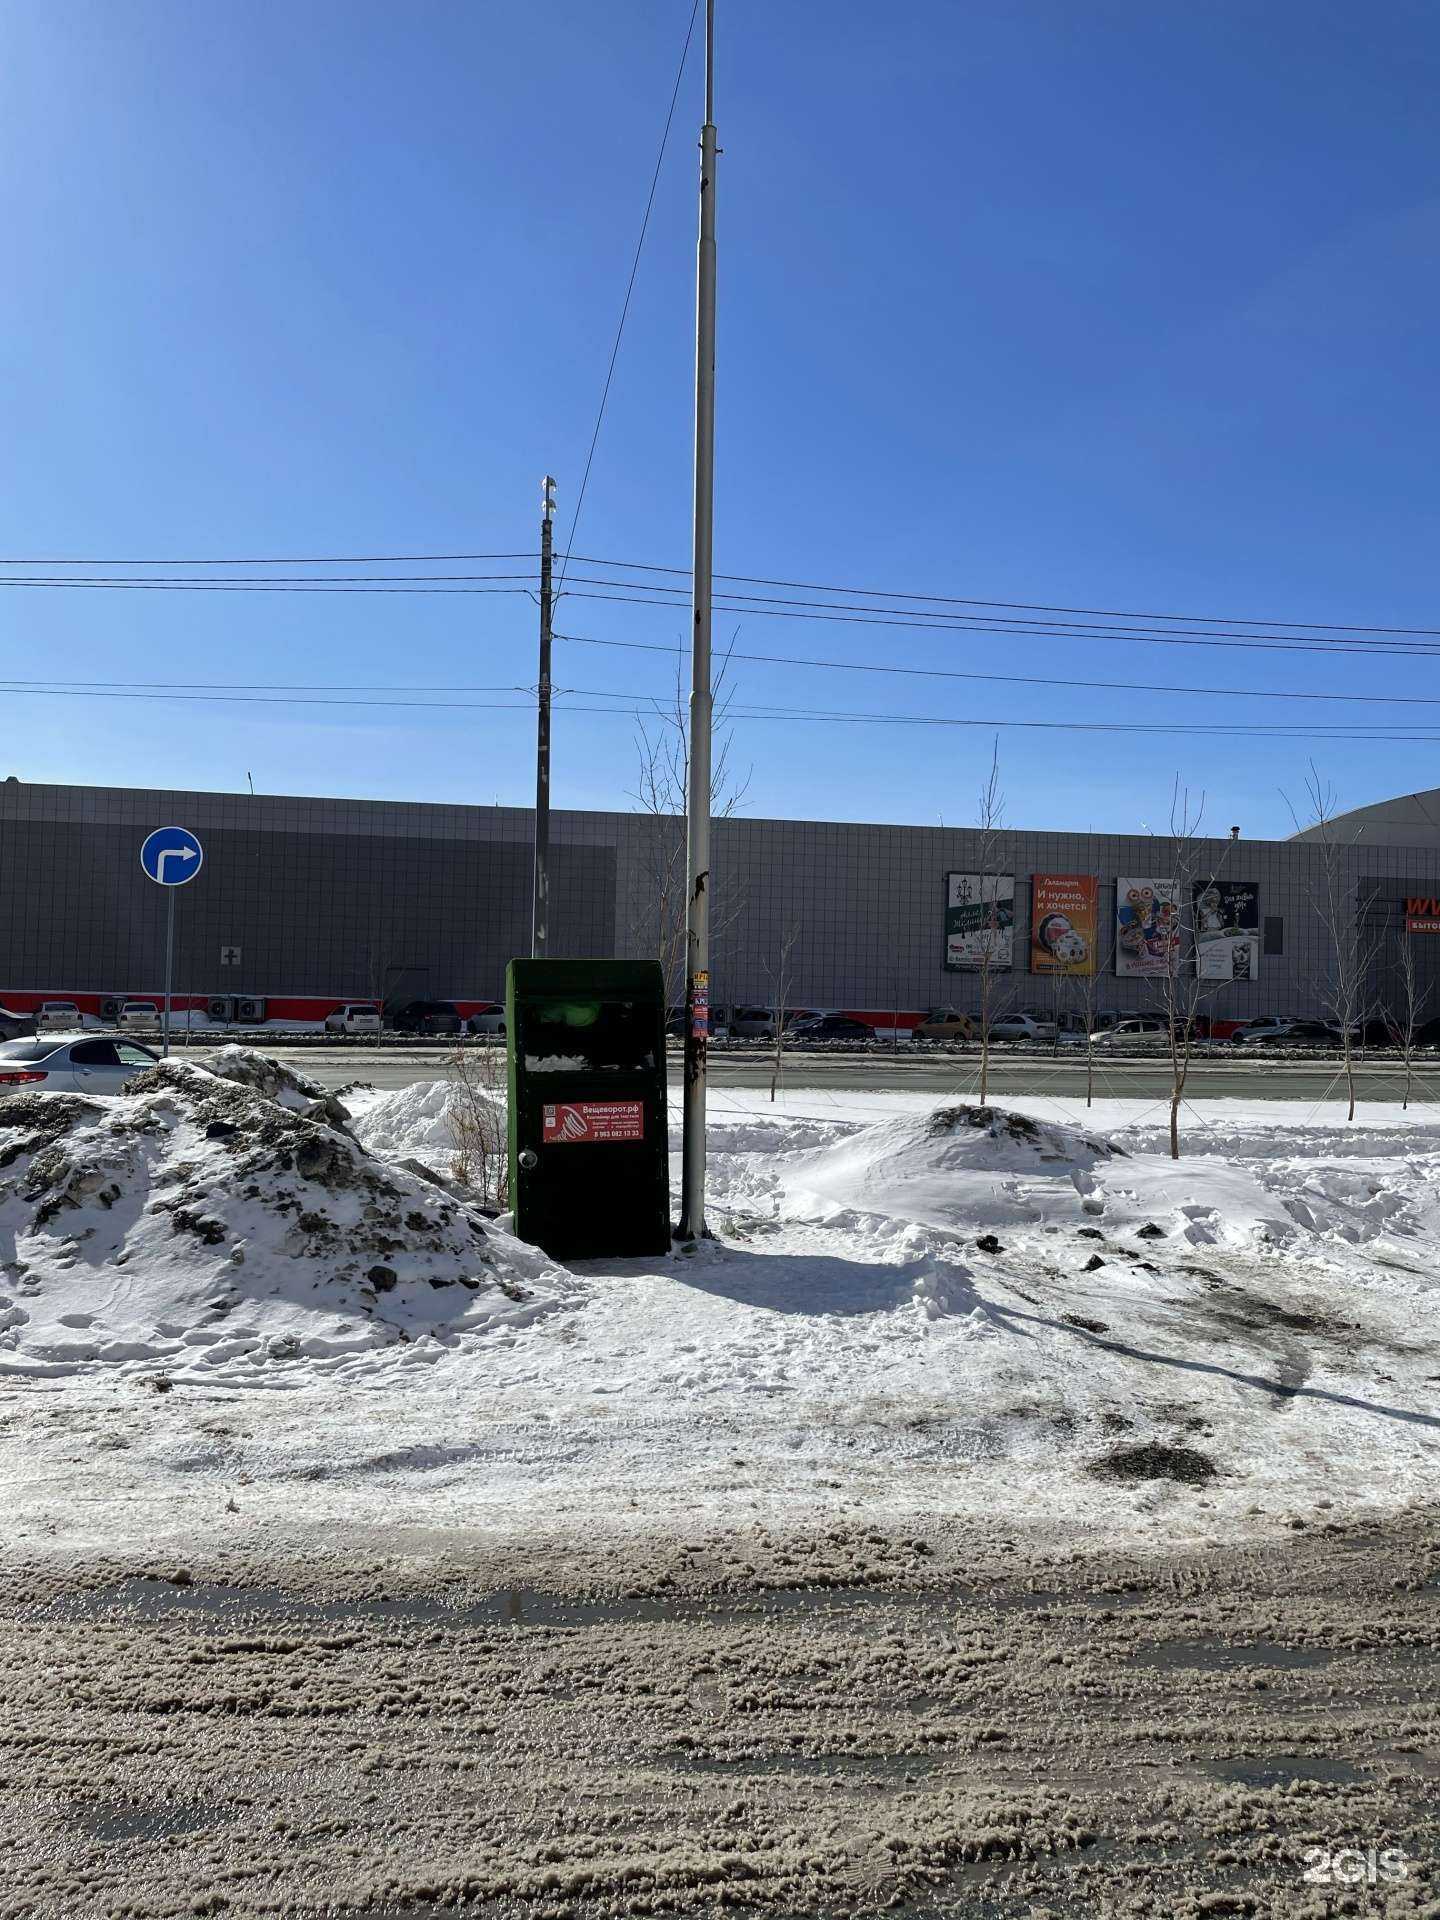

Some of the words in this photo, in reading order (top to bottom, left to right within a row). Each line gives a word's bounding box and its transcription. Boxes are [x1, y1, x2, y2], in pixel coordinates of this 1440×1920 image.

[1037, 889, 1046, 899] И
[1048, 892, 1085, 902] нужно,
[1046, 902, 1087, 911] хочется
[583, 1105, 639, 1114] Вещеворот.рф
